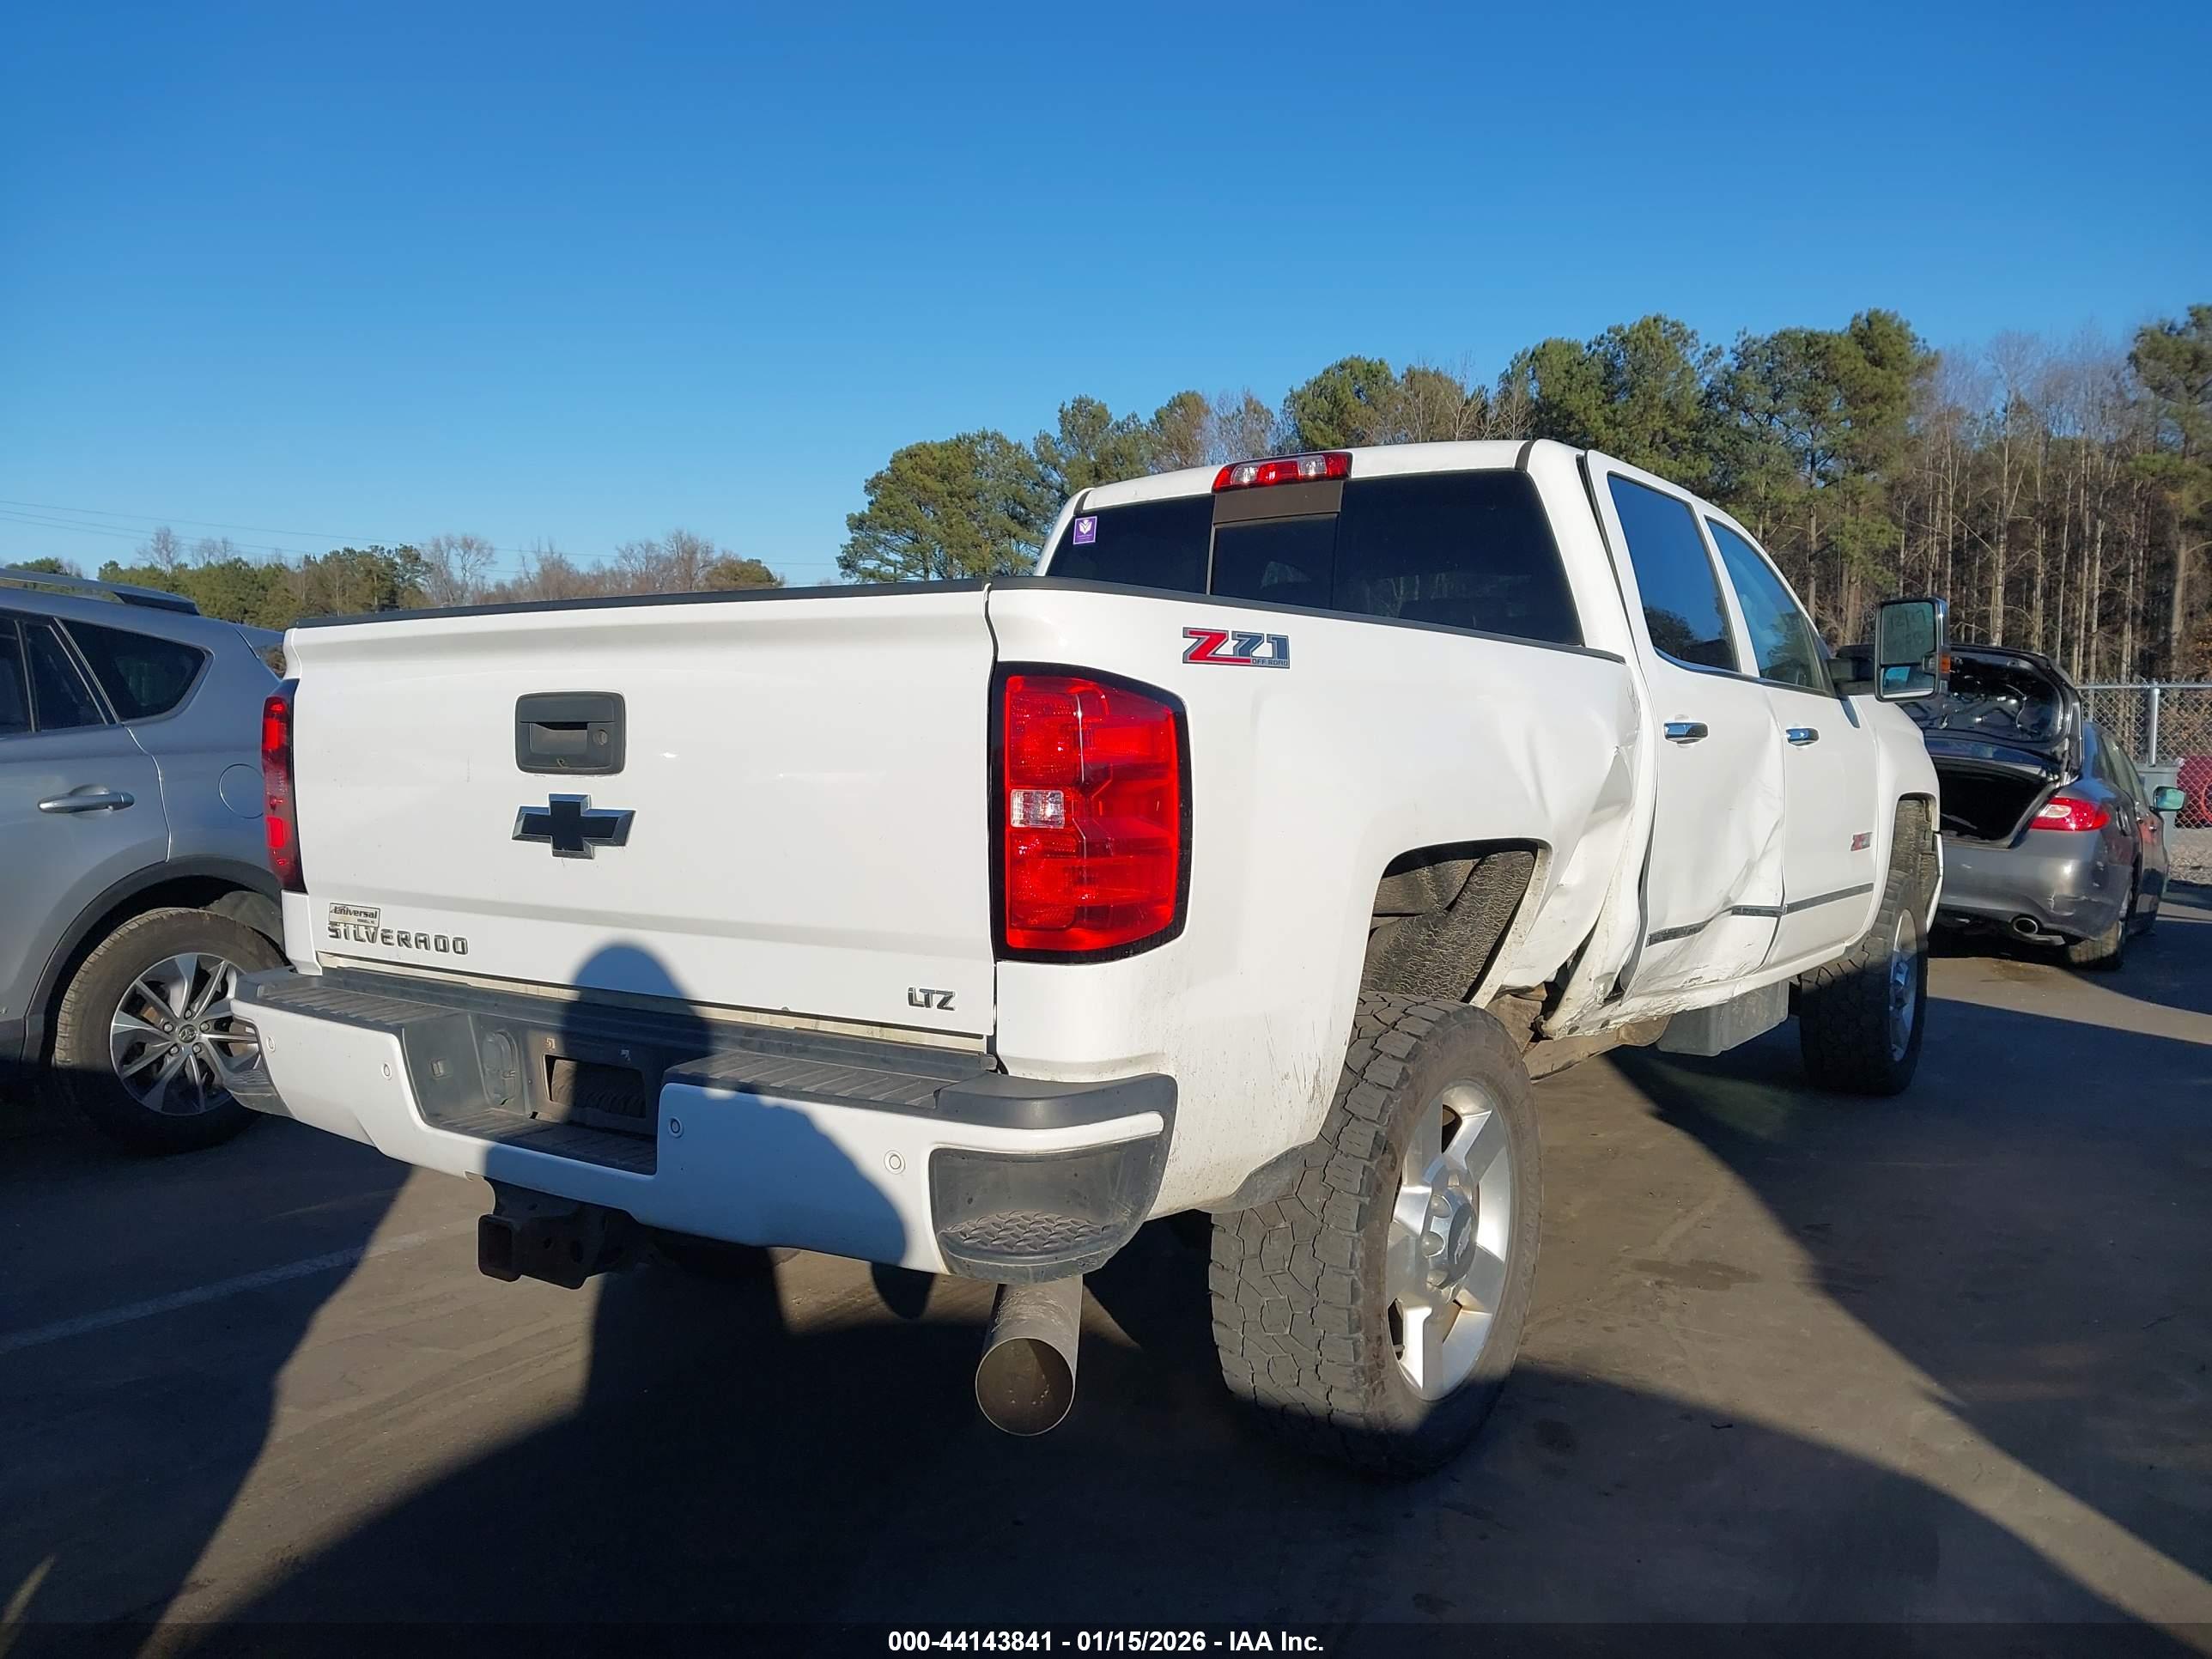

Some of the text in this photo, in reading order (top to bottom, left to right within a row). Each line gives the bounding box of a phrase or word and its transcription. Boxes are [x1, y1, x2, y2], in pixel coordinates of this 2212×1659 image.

[1182, 627, 1290, 669] Z71
[328, 922, 468, 955] SILVERADO
[908, 987, 956, 1012] LTZ
